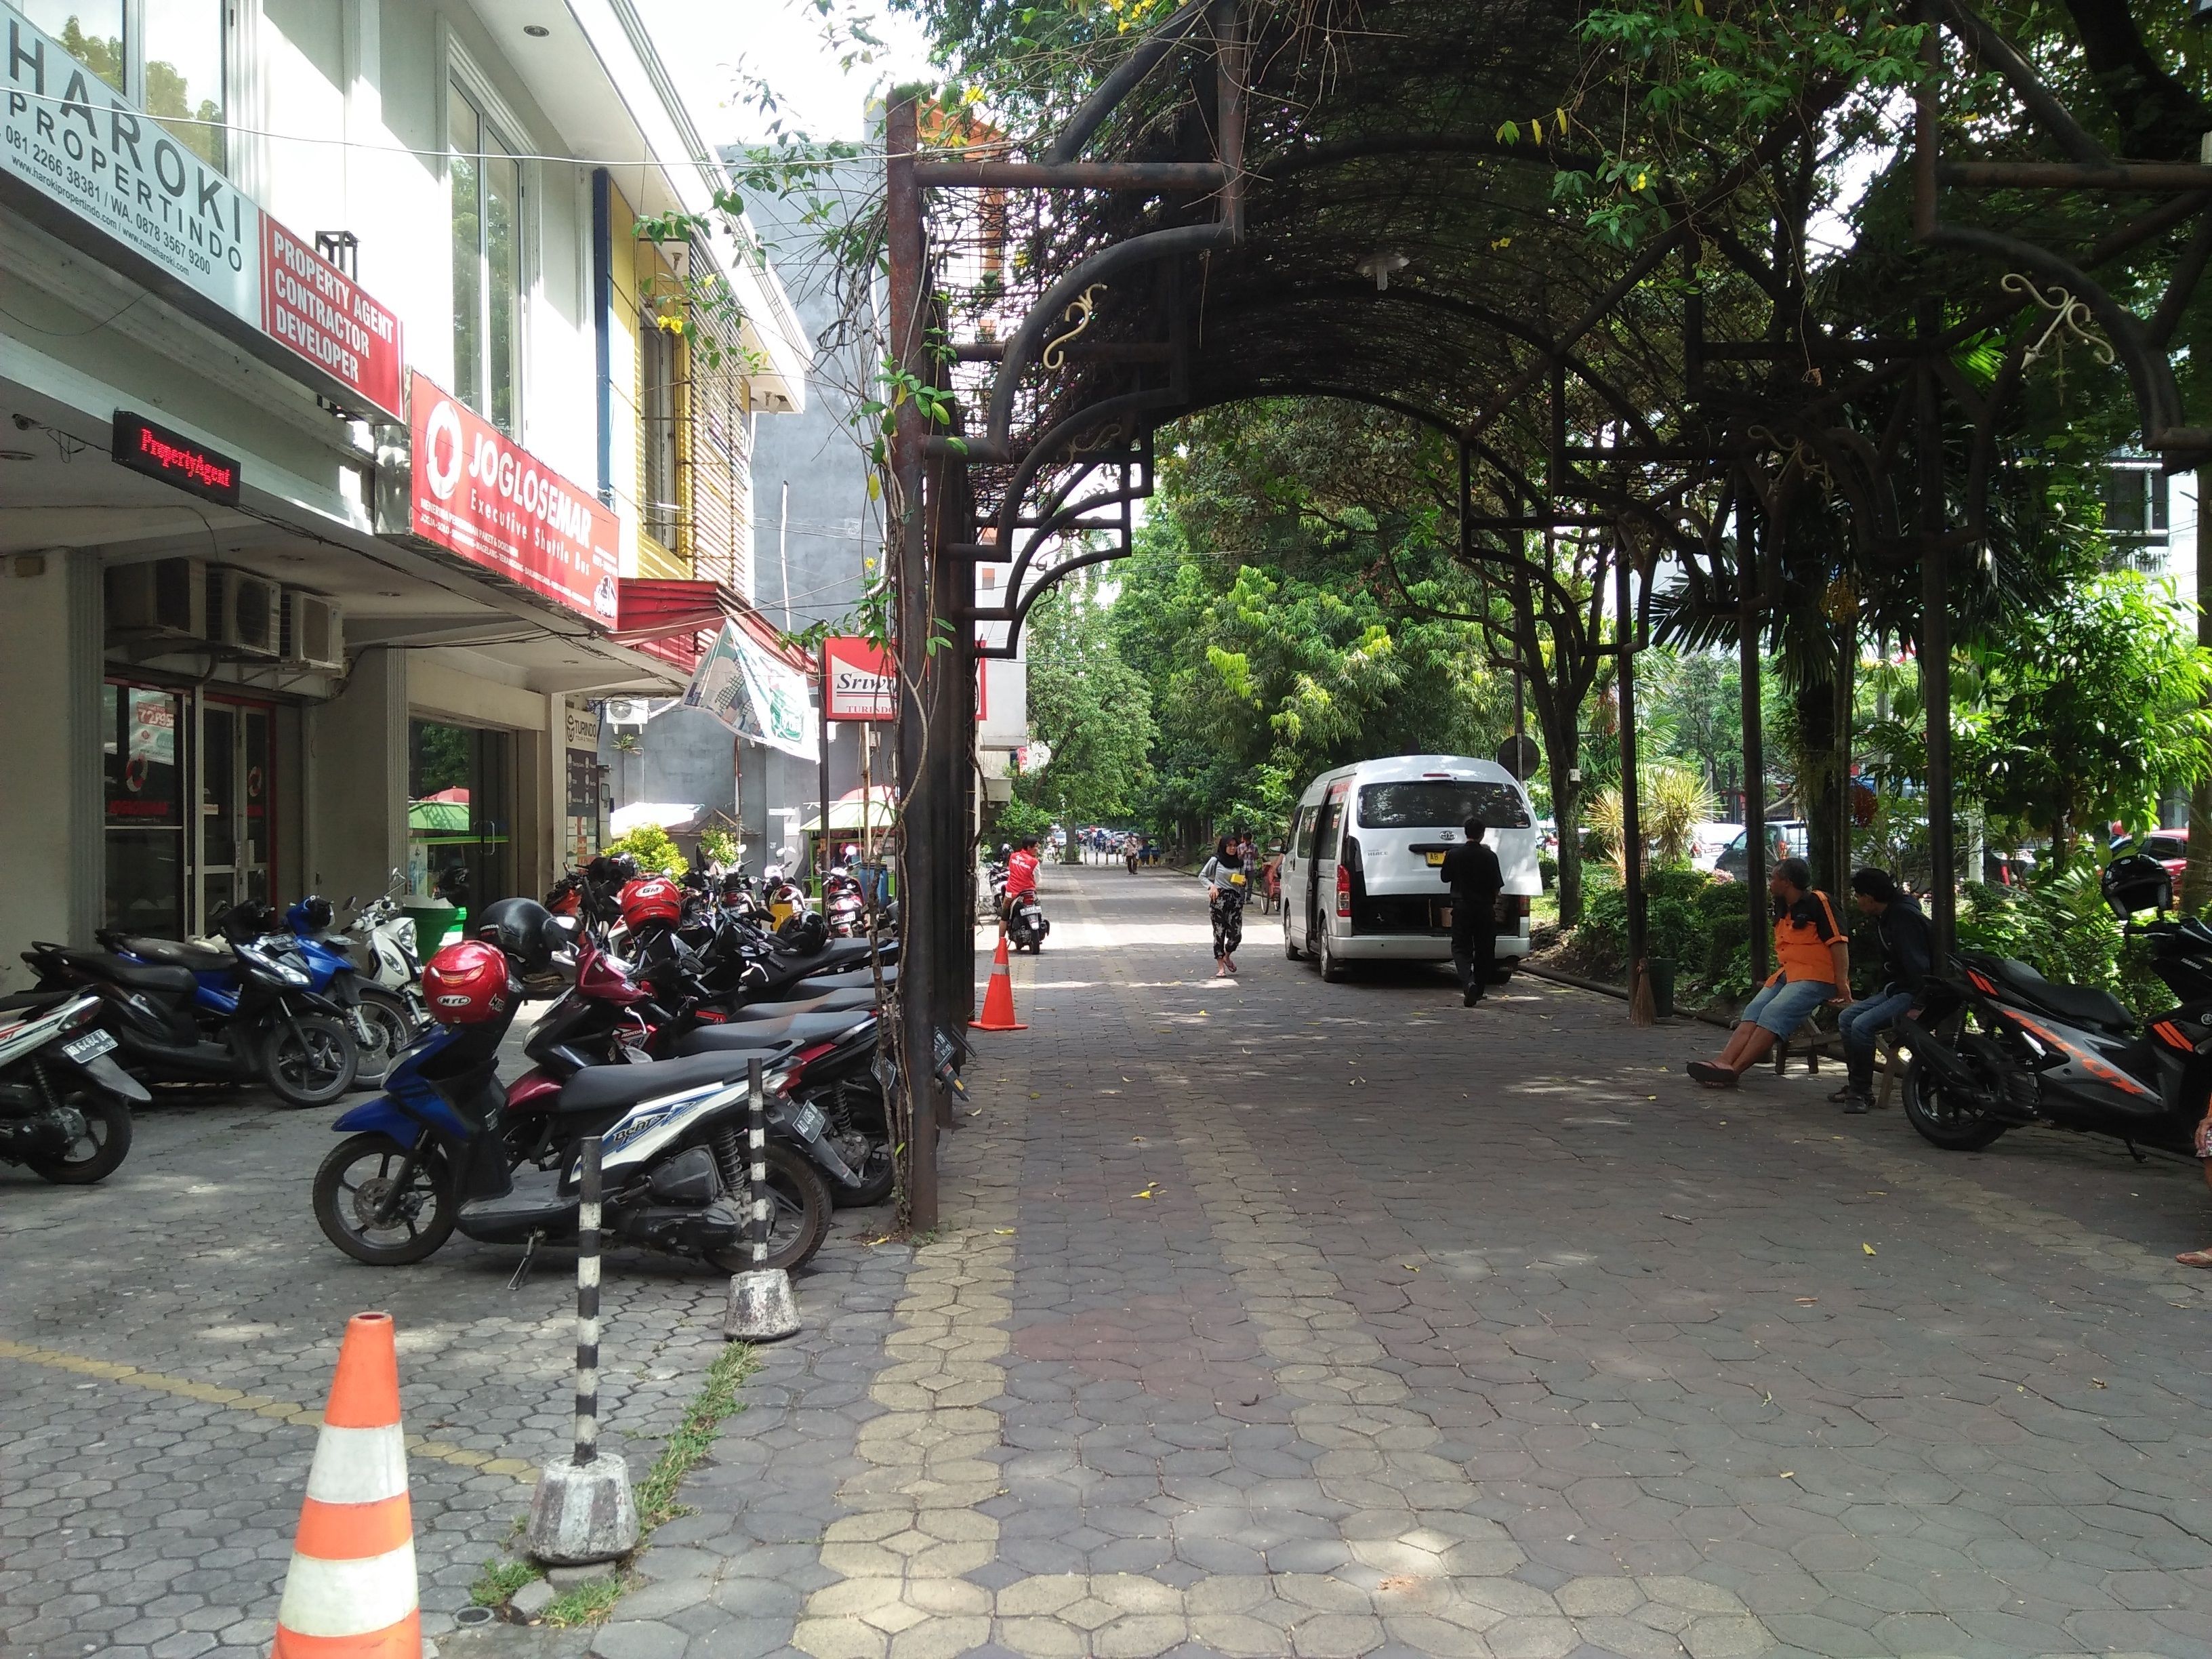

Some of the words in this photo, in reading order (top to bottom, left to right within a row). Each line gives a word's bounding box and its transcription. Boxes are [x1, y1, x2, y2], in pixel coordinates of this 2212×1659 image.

[10, 18, 241, 245] HAROKI
[5, 125, 28, 155] 081
[33, 144, 62, 177] 2266
[66, 165, 100, 203] 38381
[110, 194, 133, 224] WA.
[136, 213, 161, 242] 0878
[163, 231, 186, 258] 3567
[189, 249, 211, 275] 9200
[9, 87, 242, 272] PROPERTINDO
[12, 155, 117, 229] www.harokipropertindo.com
[123, 226, 190, 276] www.rumaharoki.com
[274, 230, 350, 310] PROPERTY
[354, 293, 394, 344] AGENT
[274, 268, 370, 359] CONTRACTOR
[276, 304, 359, 384] DEVELOPER
[468, 432, 592, 549] JOGLOSEMAR
[470, 488, 527, 540] Executive
[534, 524, 569, 565] Shuttle
[575, 551, 590, 576] Bus
[575, 720, 596, 737] TURINDO
[480, 924, 499, 932] HONDA
[66, 1046, 80, 1057] AD
[77, 1036, 99, 1051] 6484
[621, 1029, 643, 1038] HONDA
[797, 1120, 809, 1135] AD
